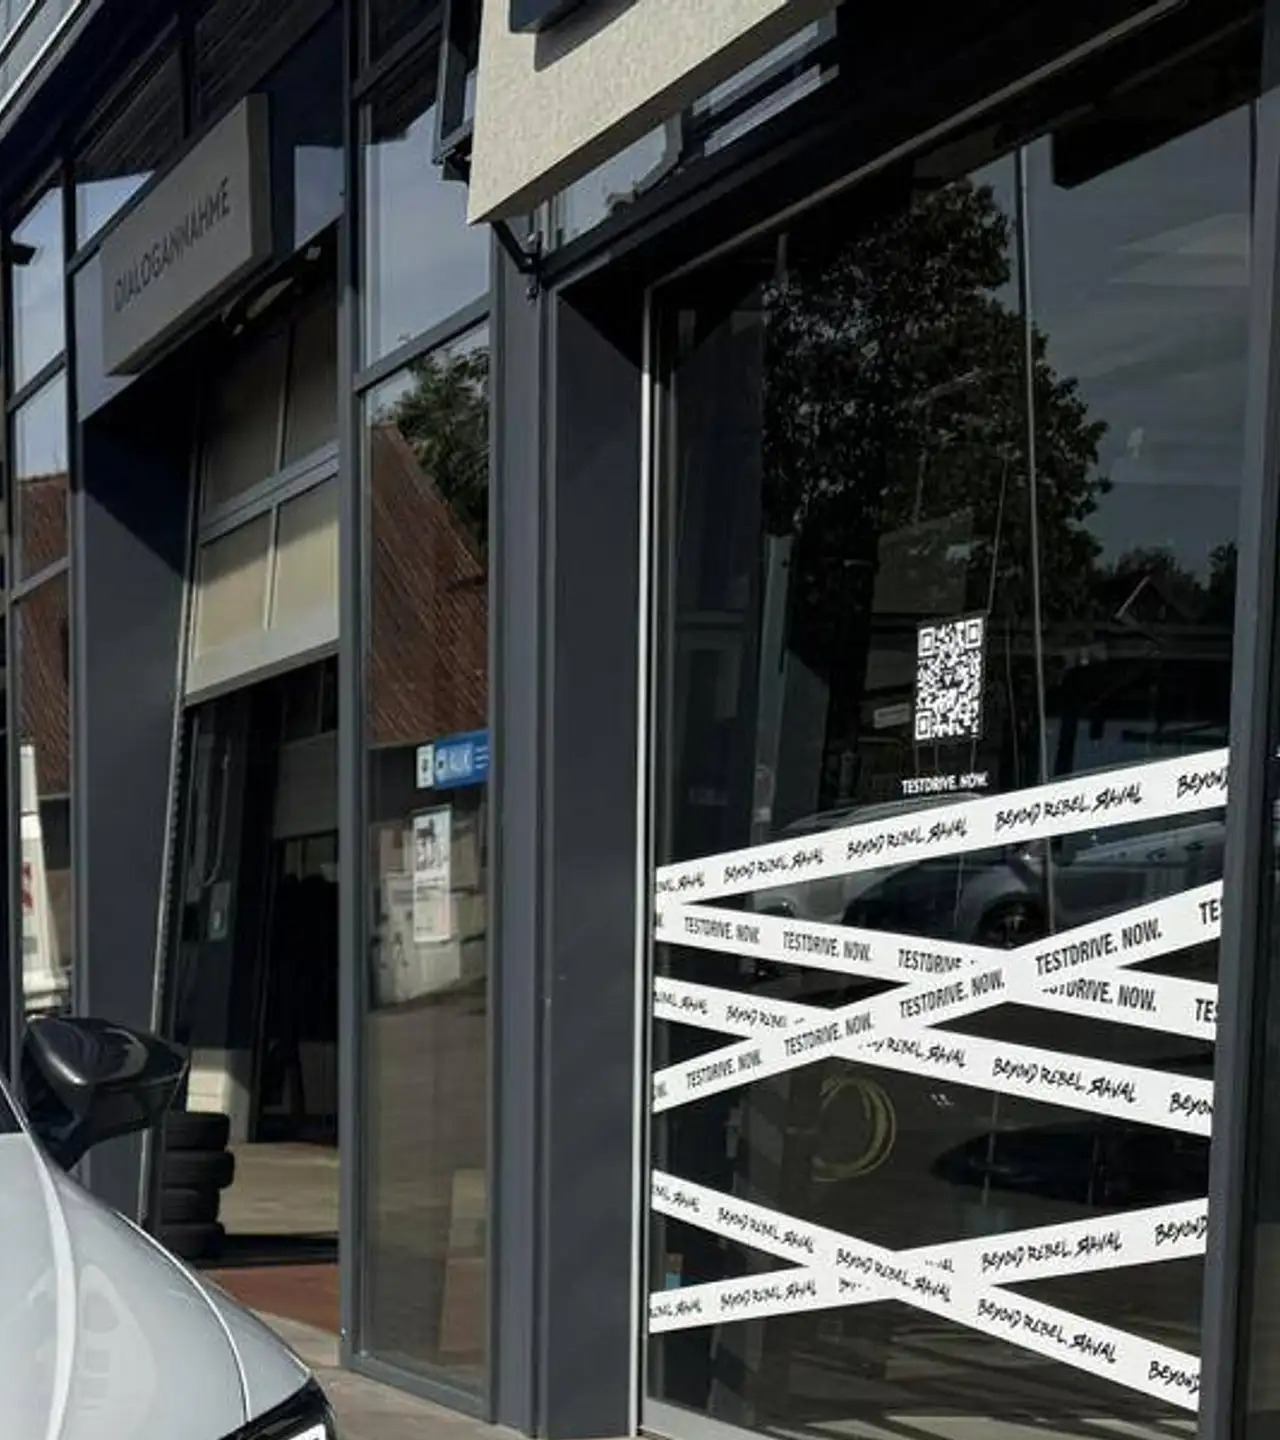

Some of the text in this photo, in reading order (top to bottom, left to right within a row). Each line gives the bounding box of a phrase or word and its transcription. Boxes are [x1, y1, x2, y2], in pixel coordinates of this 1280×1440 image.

[112, 175, 230, 312] DIALOGANNAHME
[847, 835, 884, 860] BEYOND
[996, 803, 1040, 831] BEYOND
[844, 942, 869, 961] NOW.
[1118, 985, 1156, 1012] NOW.
[846, 1013, 871, 1035] NOW.
[898, 982, 969, 1017] TESTDRIVE.
[971, 970, 1005, 996] NOW.
[1034, 933, 1117, 975] TESTDRIVE.
[1122, 918, 1162, 949] NOW.
[993, 1058, 1038, 1084] BEYOND
[982, 1246, 1024, 1272] BEYOND
[978, 1299, 1021, 1328] BEYOND
